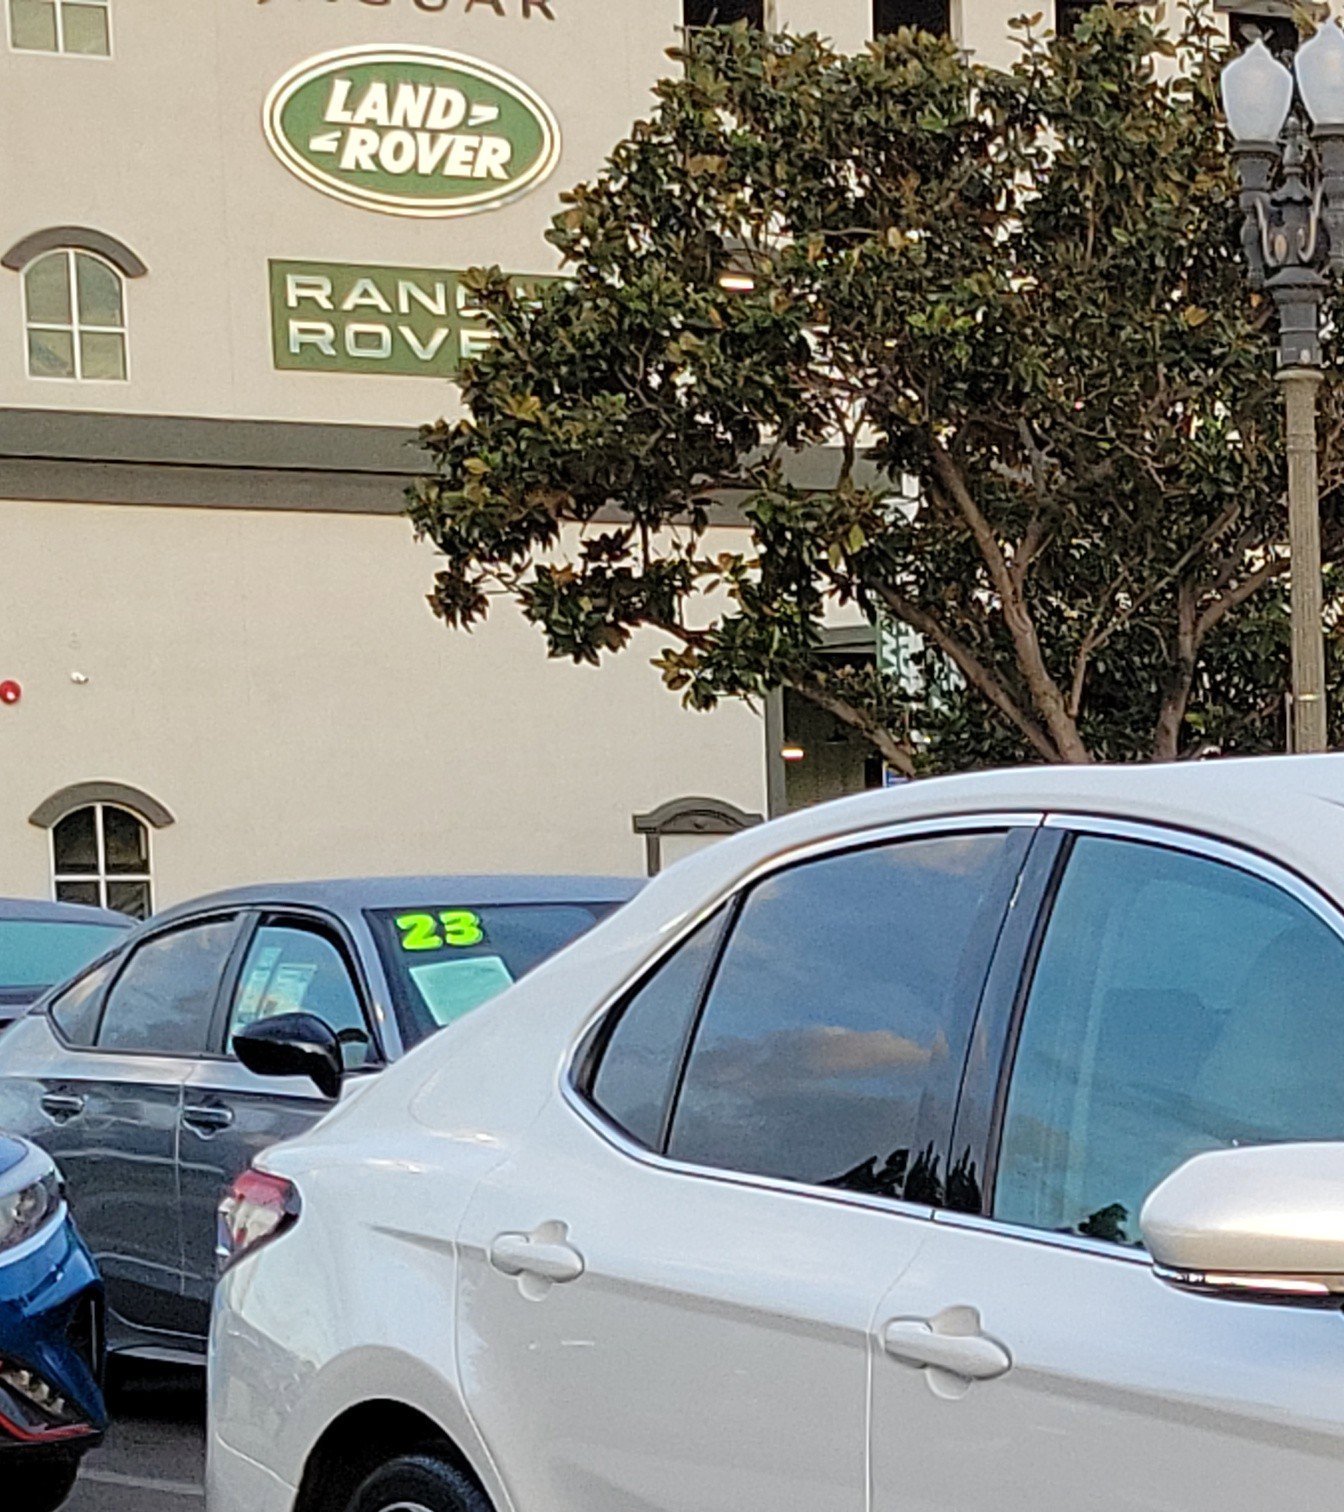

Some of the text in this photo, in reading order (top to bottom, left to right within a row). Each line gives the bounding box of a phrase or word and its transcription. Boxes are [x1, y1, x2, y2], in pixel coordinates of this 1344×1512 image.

[324, 78, 467, 131] LAND
[338, 125, 513, 180] ROVER
[286, 273, 505, 318] RAN
[288, 318, 497, 361] ROVE
[396, 910, 484, 950] 23
